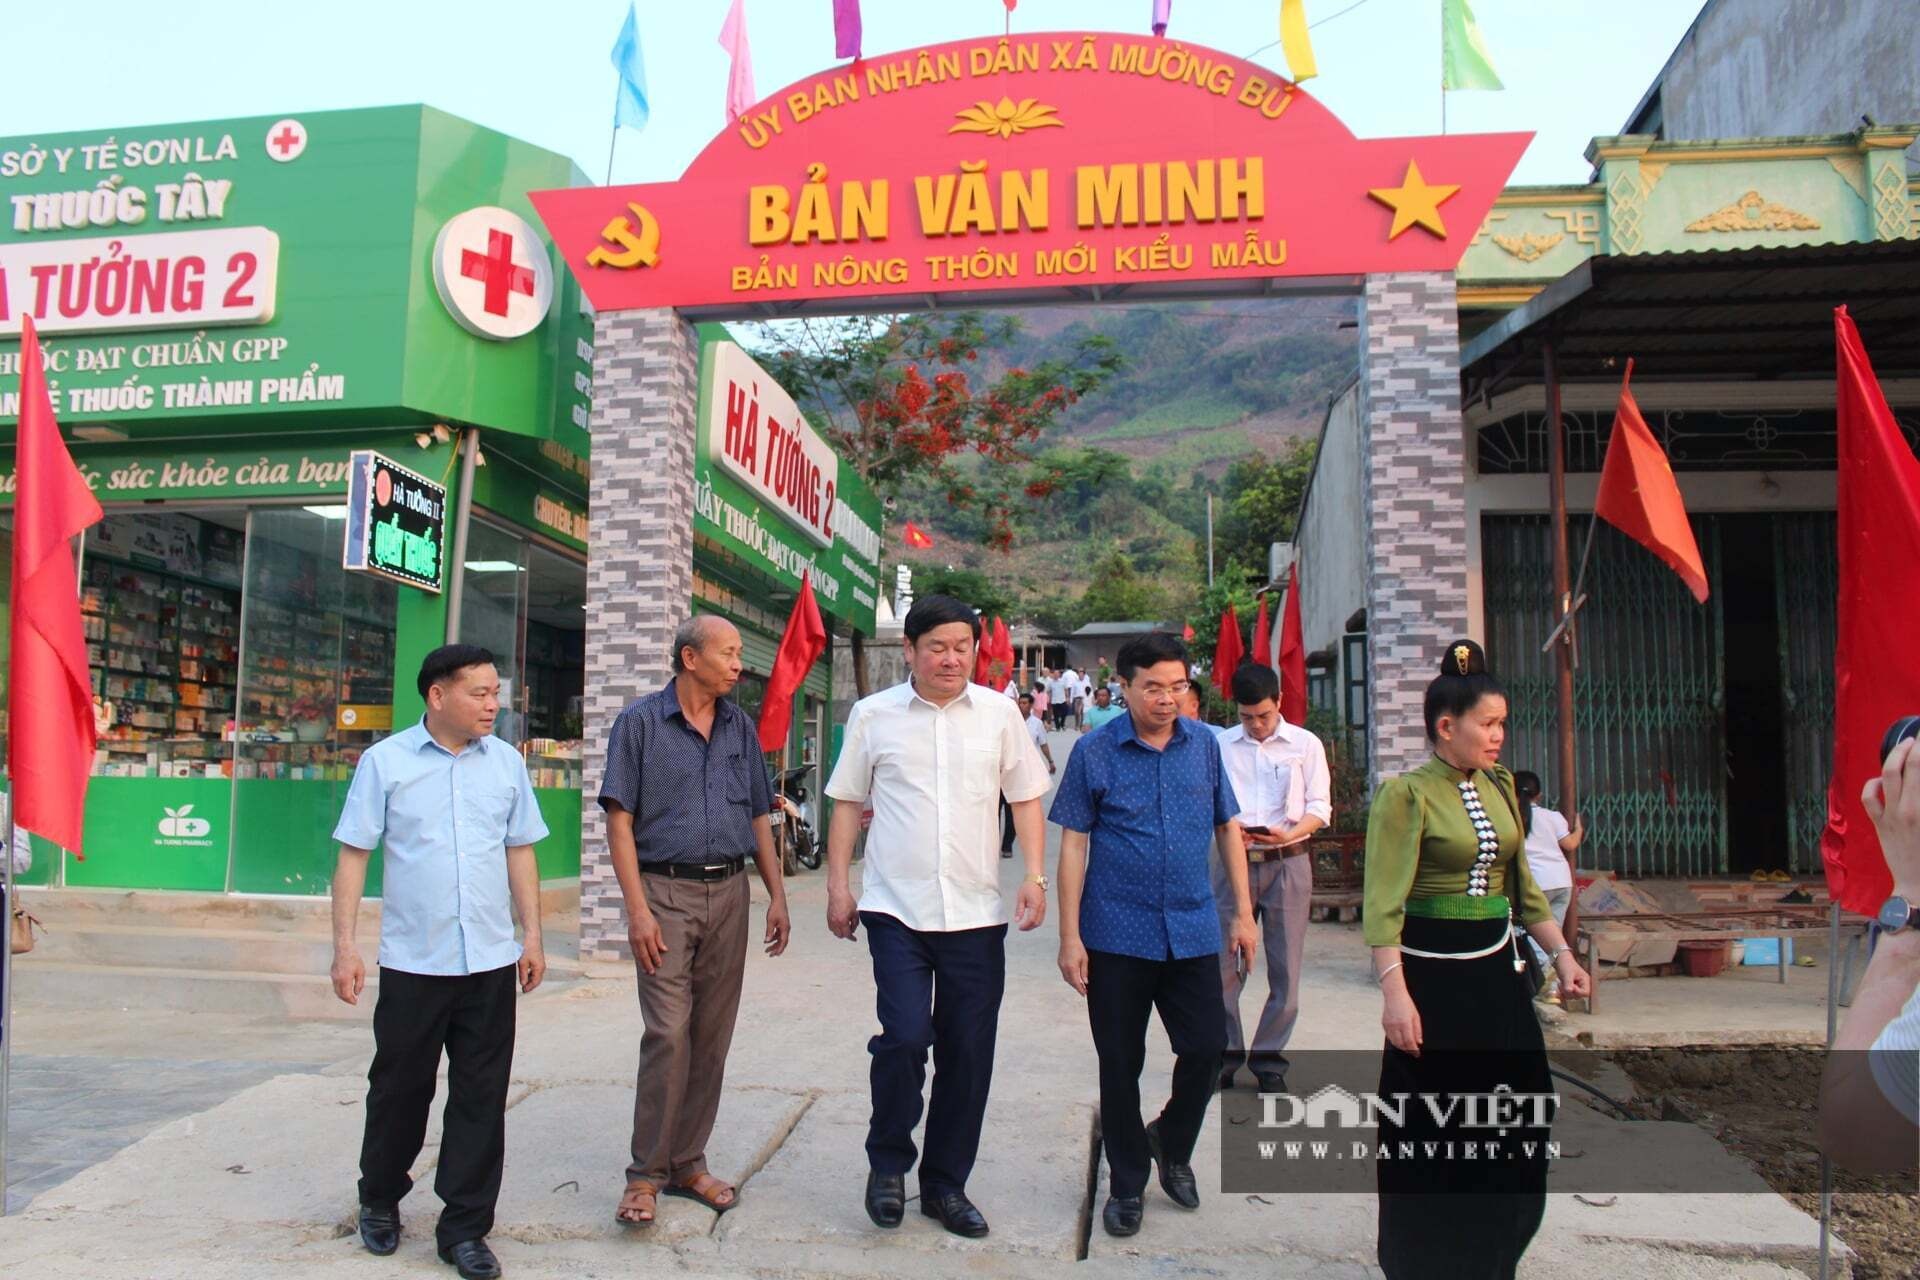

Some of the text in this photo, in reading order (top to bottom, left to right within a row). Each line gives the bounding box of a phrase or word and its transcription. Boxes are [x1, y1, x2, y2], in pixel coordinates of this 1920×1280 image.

[738, 108, 783, 150] ỦY
[787, 74, 860, 121] BAN
[866, 50, 962, 97] NHÂN
[970, 39, 1039, 77] DÂN
[1050, 36, 1099, 72] XÃ
[1109, 42, 1236, 95] MƯỜNG
[1, 134, 238, 177] SỞ Y TẾ SƠN LA
[10, 172, 232, 233] THUỐC TÂY
[748, 156, 1266, 247] BẢN VĂN MINH
[30, 241, 206, 319] TƯỞNG
[222, 251, 258, 308] 2
[731, 229, 1289, 291] BẢN NÔNG THÔN MỚI KIỂU MẪU
[75, 346, 127, 375] ĐẠT
[131, 331, 226, 369] CHUẨN
[232, 337, 288, 362] GPP
[69, 375, 154, 413] THUỐC
[162, 377, 253, 409] THÀNH
[260, 363, 345, 403] PHẨM
[107, 456, 155, 490] sức
[159, 456, 229, 488] khỏe
[234, 456, 290, 485] của
[724, 379, 759, 476] HÀ
[764, 416, 821, 529] TƯỞNG
[823, 480, 834, 539] 2
[694, 470, 723, 527] UẦY
[724, 507, 767, 555] THUỐC
